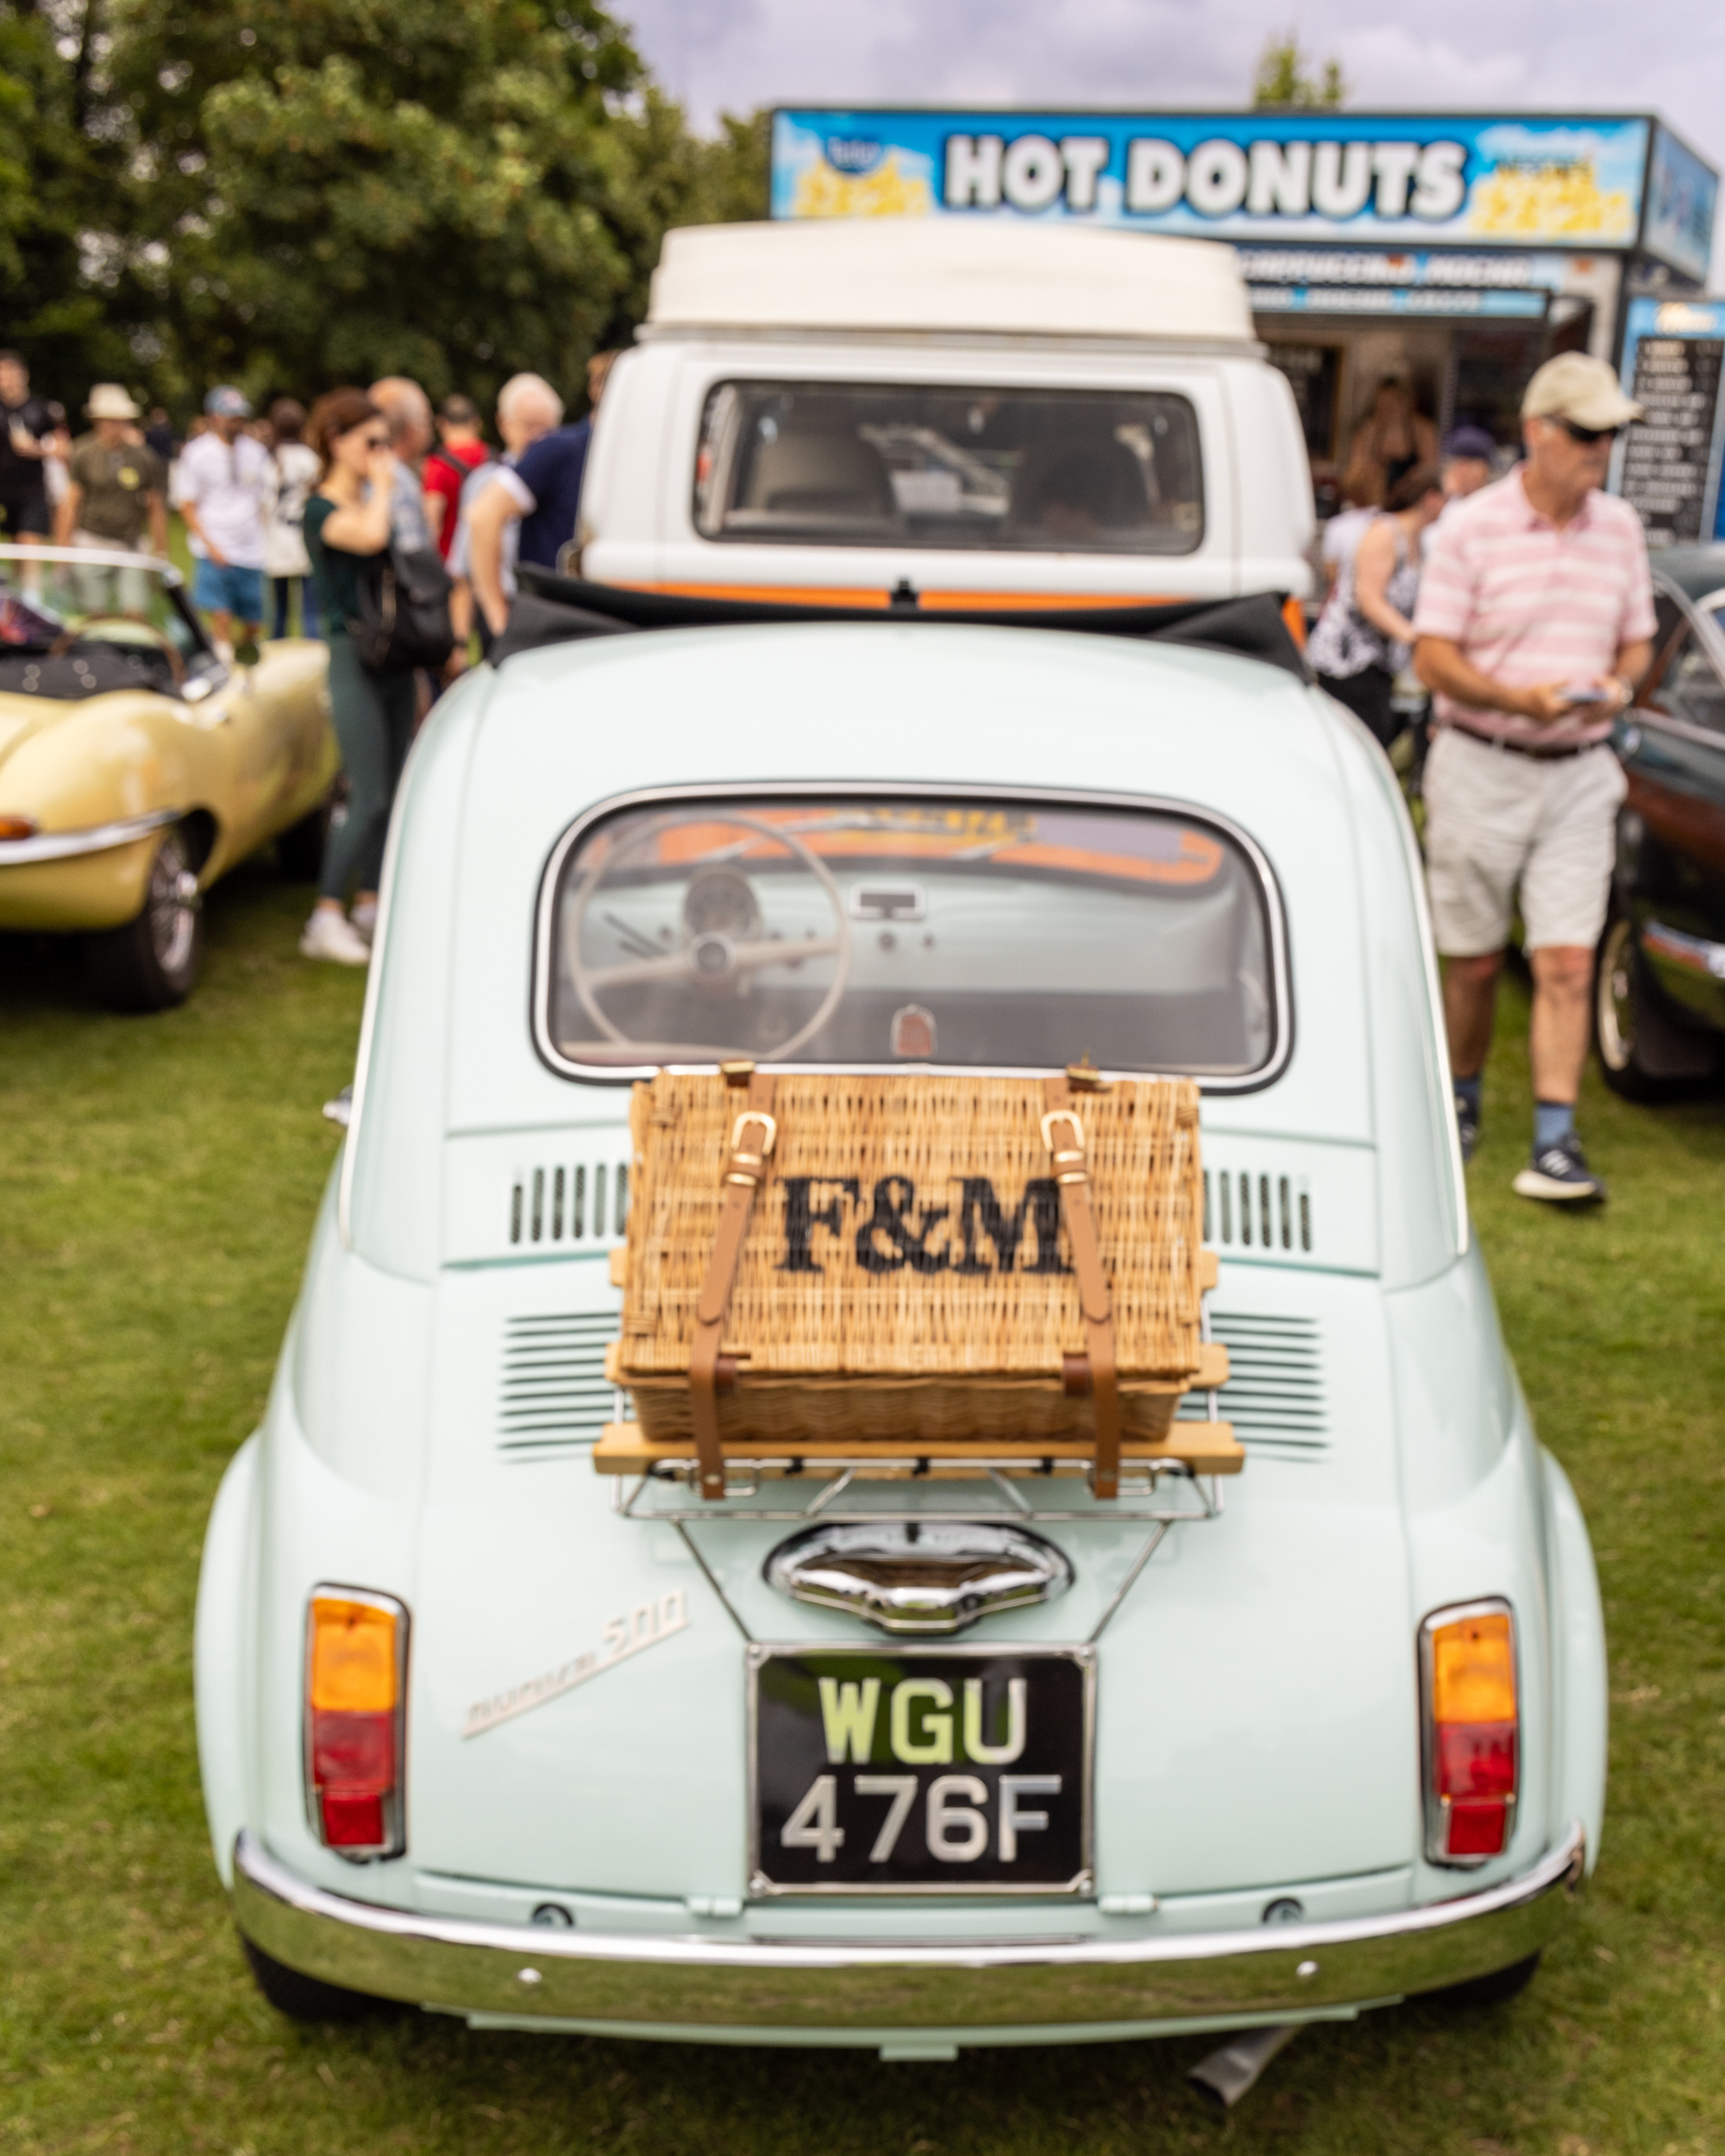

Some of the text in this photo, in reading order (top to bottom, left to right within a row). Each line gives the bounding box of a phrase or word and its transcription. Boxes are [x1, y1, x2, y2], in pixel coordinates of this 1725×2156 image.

[946, 133, 1467, 220] HOT DONUTS
[775, 1175, 1076, 1275] F&M
[602, 1589, 689, 1658] 500
[818, 1677, 1027, 1765] WGU
[780, 1774, 1063, 1863] 476F
